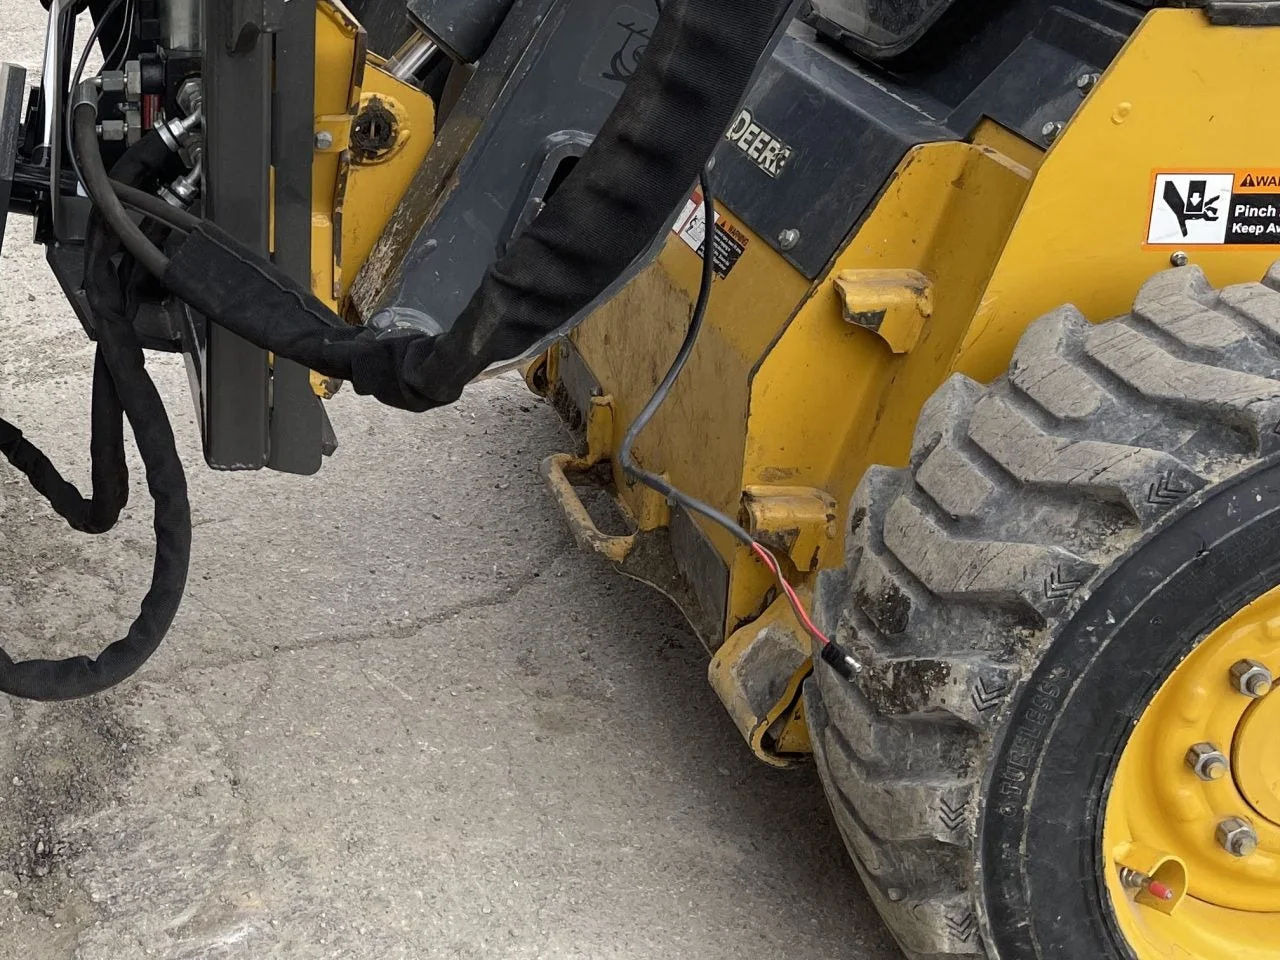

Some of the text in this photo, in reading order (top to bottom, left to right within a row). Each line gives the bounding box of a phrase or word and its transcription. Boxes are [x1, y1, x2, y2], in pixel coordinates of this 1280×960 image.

[1256, 175, 1280, 187] WA
[1234, 204, 1277, 218] Pinch
[1232, 222, 1264, 236] Keep
[1001, 681, 1061, 796] TUBELESS
